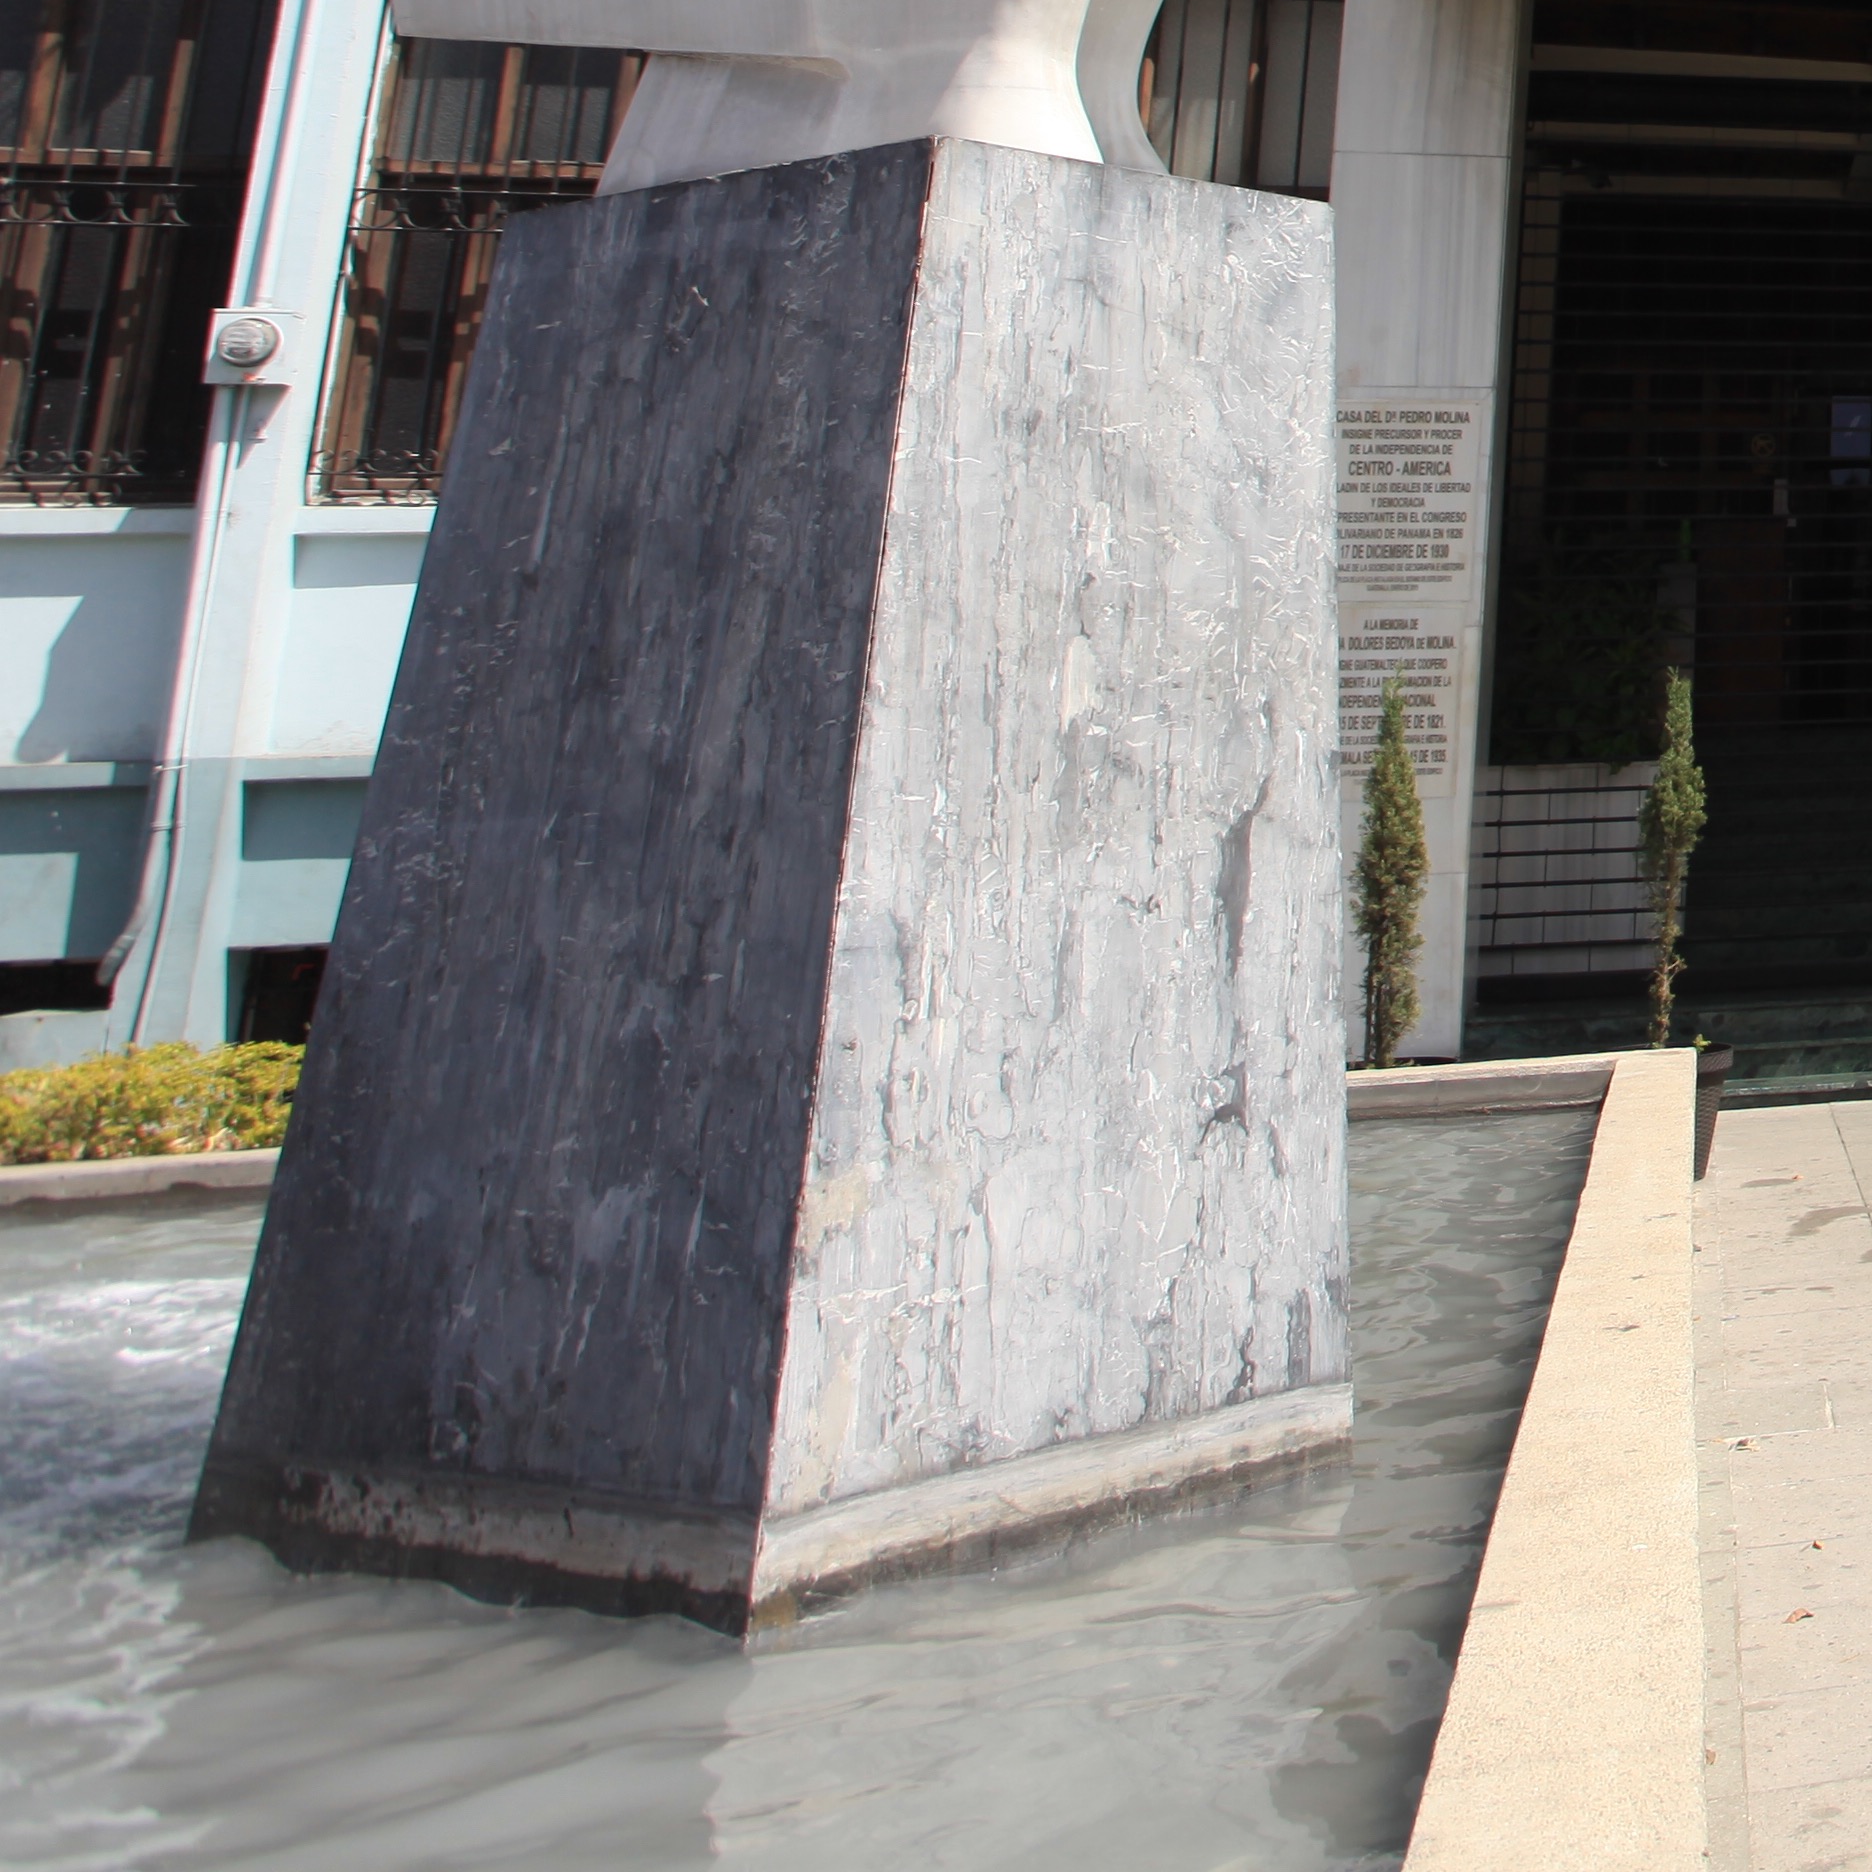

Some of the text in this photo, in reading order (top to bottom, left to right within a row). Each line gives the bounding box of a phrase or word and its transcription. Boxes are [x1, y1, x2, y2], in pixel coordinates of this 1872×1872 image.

[1336, 411, 1362, 423] CASA
[1365, 411, 1382, 423] DEL
[1400, 411, 1432, 423] PEDRO
[1434, 411, 1470, 423] MOLINA
[1342, 430, 1462, 439] INSIGNE PRECURSOR Y PROCER
[1350, 444, 1453, 454] DE LA INDEPENDENCIA DE
[1348, 461, 1393, 476] CENTRO
[1402, 461, 1451, 476] AMERICA
[1336, 483, 1471, 493] LADIN DE LOS IDEALES DE LIBERTAD
[1371, 498, 1425, 508] Y DEMOCRACIA
[1337, 512, 1467, 523] PRESENTANTE EN EL CONGRESO
[1385, 529, 1395, 539] DE
[1397, 529, 1431, 539] PANAMA
[1433, 529, 1444, 539] EN
[1340, 544, 1449, 559] 17 DE DICIEMBRE DE 1930
[1363, 619, 1419, 630] A LA MEMORIA DE
[1349, 636, 1384, 650] DOLORES
[1386, 636, 1414, 650] BEDOYA
[1416, 637, 1425, 649] DE
[1348, 715, 1359, 729] DE
[1414, 715, 1424, 729] DE
[1419, 750, 1429, 763] DE
